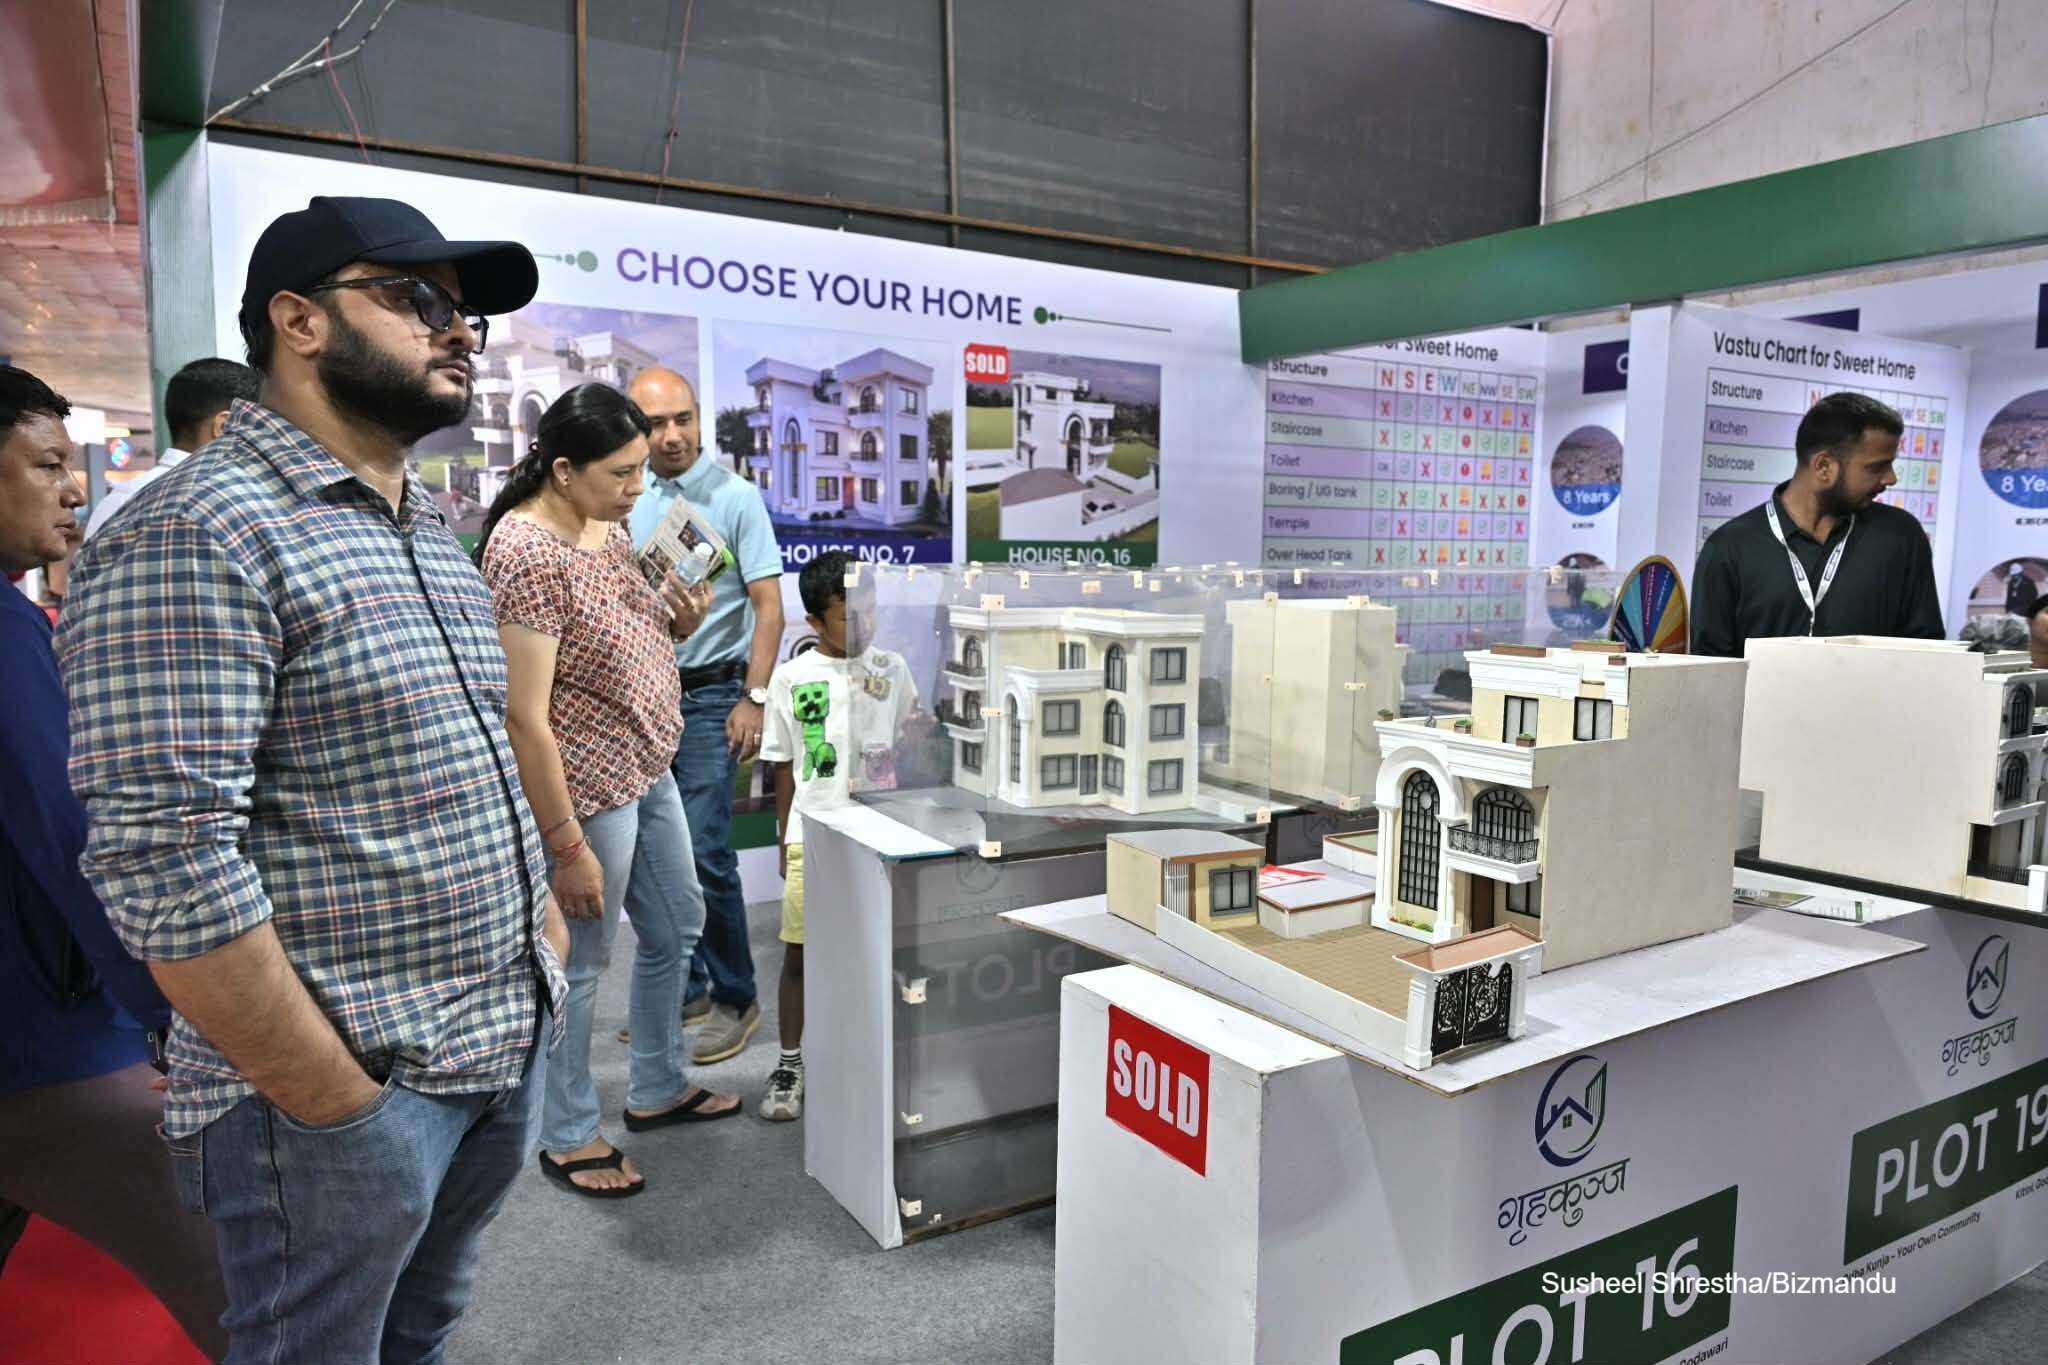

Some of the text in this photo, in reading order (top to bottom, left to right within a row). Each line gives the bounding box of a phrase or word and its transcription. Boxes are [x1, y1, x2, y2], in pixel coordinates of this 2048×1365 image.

[616, 247, 1023, 325] CHOOSE YOUR HOME
[1454, 341, 1499, 361] Home
[1713, 331, 1916, 381] Vastu Chart for Sweet Home
[965, 351, 1007, 375] SOLD
[1271, 358, 1328, 377] Structure
[1381, 368, 1394, 388] N
[1404, 370, 1415, 389] S
[1425, 373, 1433, 391] E
[1439, 376, 1457, 393] W
[1271, 393, 1314, 407] Kitchen
[1711, 380, 1763, 401] Structure
[1271, 421, 1323, 437] Staircase
[1709, 420, 1748, 437] Kitchen
[1270, 454, 1300, 468] Toilet
[1706, 454, 1755, 471] Staircase
[2001, 474, 2048, 493] 8 Ye
[1575, 490, 1611, 504] Years
[1704, 491, 1733, 507] Toilet
[1268, 516, 1310, 532] Temple
[859, 544, 898, 563] NO.
[902, 545, 917, 563] 7
[1008, 547, 1132, 566] HOUSE NO. 16
[1328, 549, 1353, 561] Tank
[1113, 1038, 1200, 1137] SOLD
[1874, 1084, 2048, 1217] PLOT 19
[1917, 1232, 1937, 1248] Own
[1937, 1211, 1981, 1239] Community
[1635, 1237, 1700, 1332] 16
